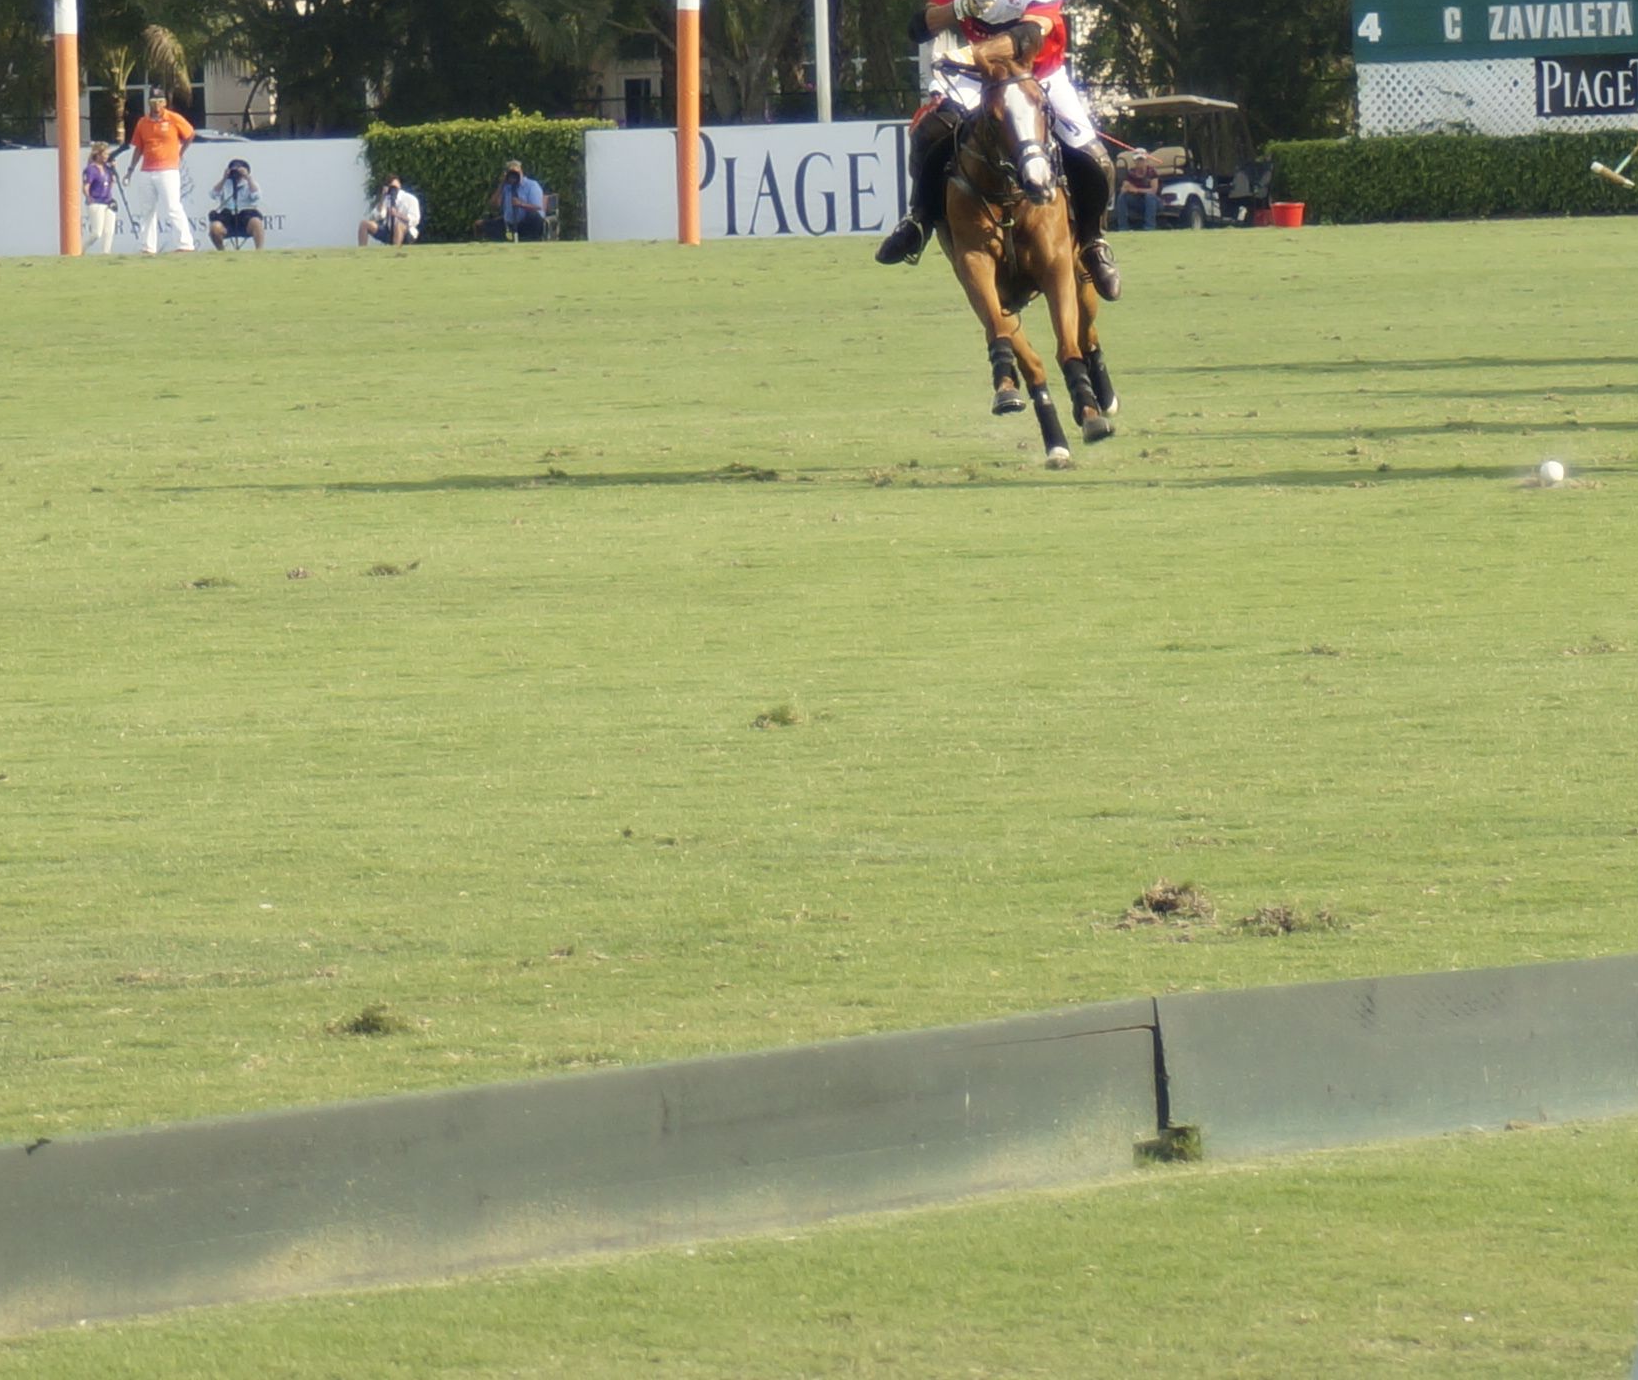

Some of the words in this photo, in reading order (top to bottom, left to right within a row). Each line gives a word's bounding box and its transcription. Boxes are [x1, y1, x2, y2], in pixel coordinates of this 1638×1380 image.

[1358, 12, 1381, 42] 4
[1444, 7, 1461, 40] C
[1488, 1, 1633, 40] ZAVALETA
